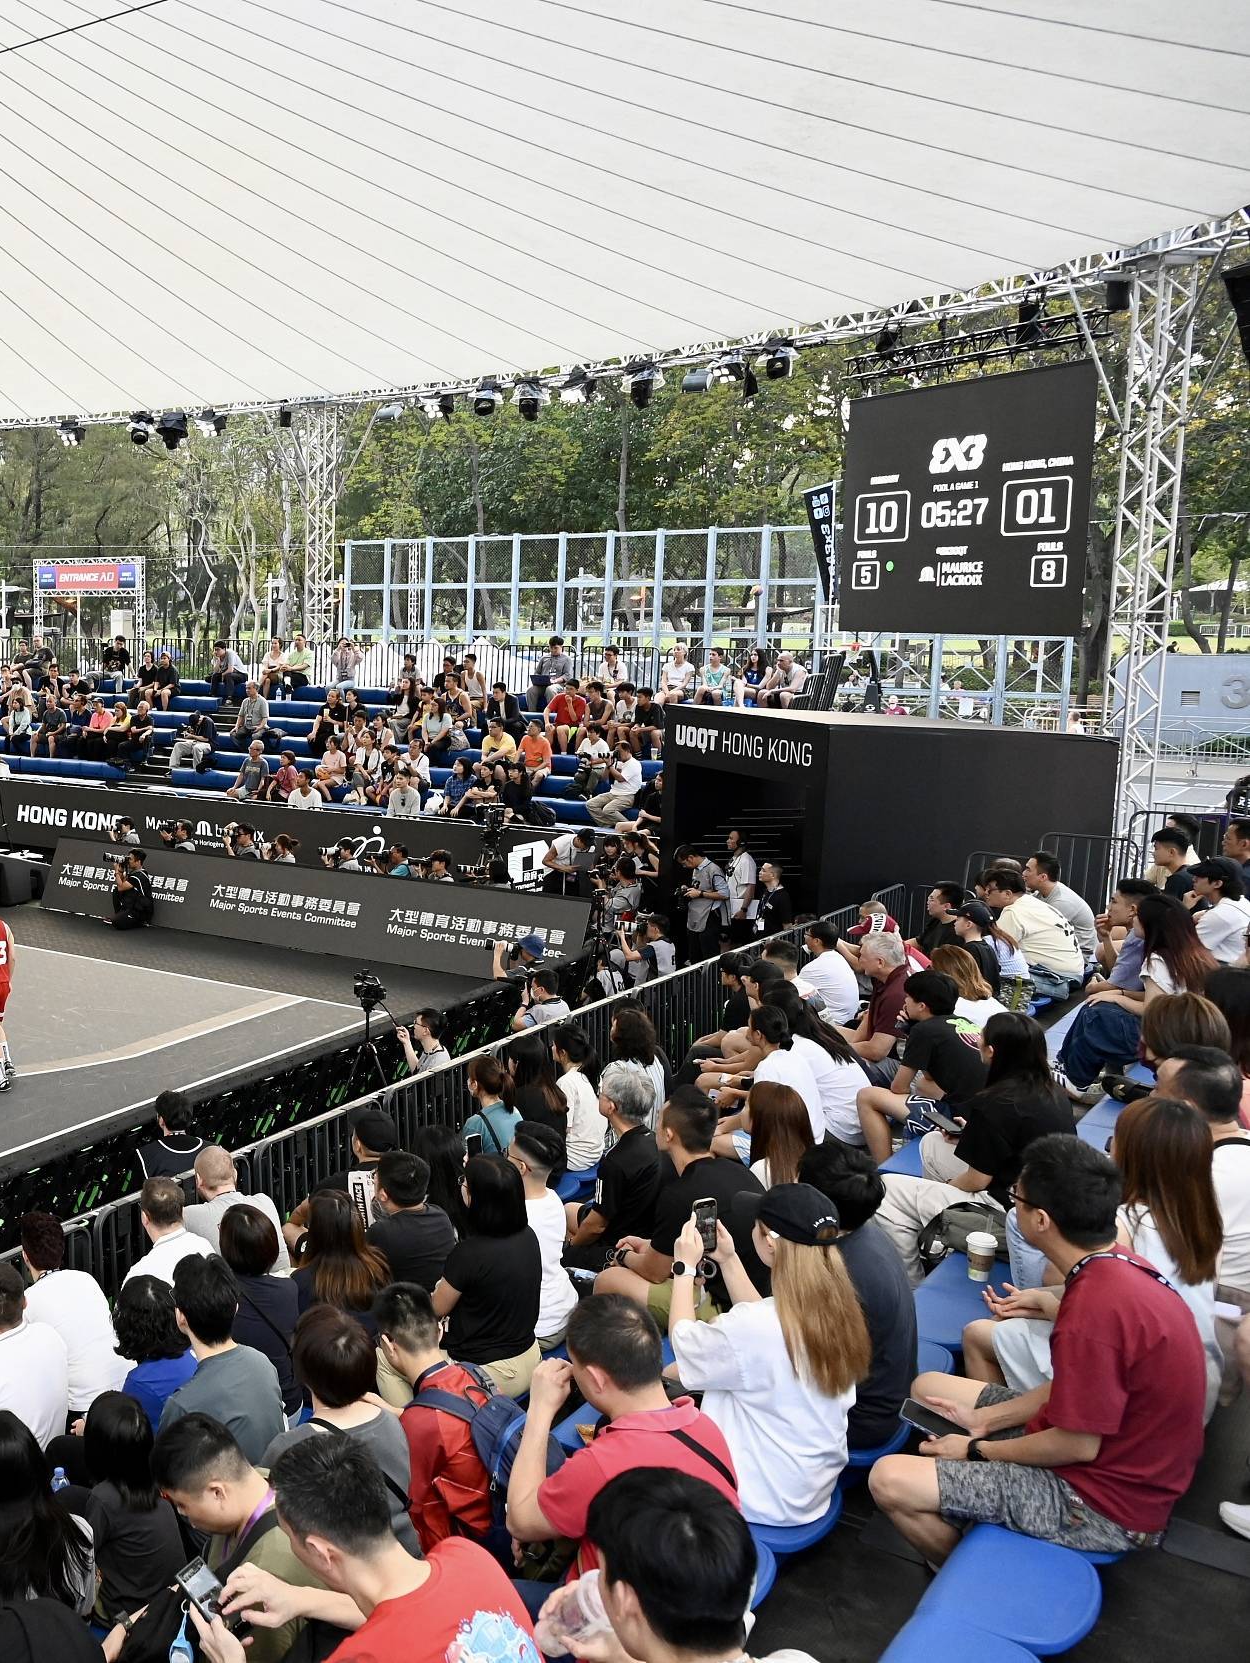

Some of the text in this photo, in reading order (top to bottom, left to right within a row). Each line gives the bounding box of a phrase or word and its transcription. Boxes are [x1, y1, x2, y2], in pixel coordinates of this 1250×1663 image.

[865, 500, 898, 534] 10
[920, 498, 989, 528] 05:27
[1016, 488, 1056, 524] 01
[59, 572, 99, 582] ENTRANCE
[860, 566, 872, 584] 5
[942, 561, 984, 574] MAURICE
[1041, 560, 1056, 582] 8
[940, 574, 982, 586] LACROIX
[675, 724, 812, 767] UOQT HONG KONG
[17, 804, 67, 827] HONG
[58, 876, 82, 888] Major
[84, 880, 108, 892] Sports
[209, 898, 357, 928] Major Sports Events Committee
[387, 923, 487, 946] Major Sports Even
